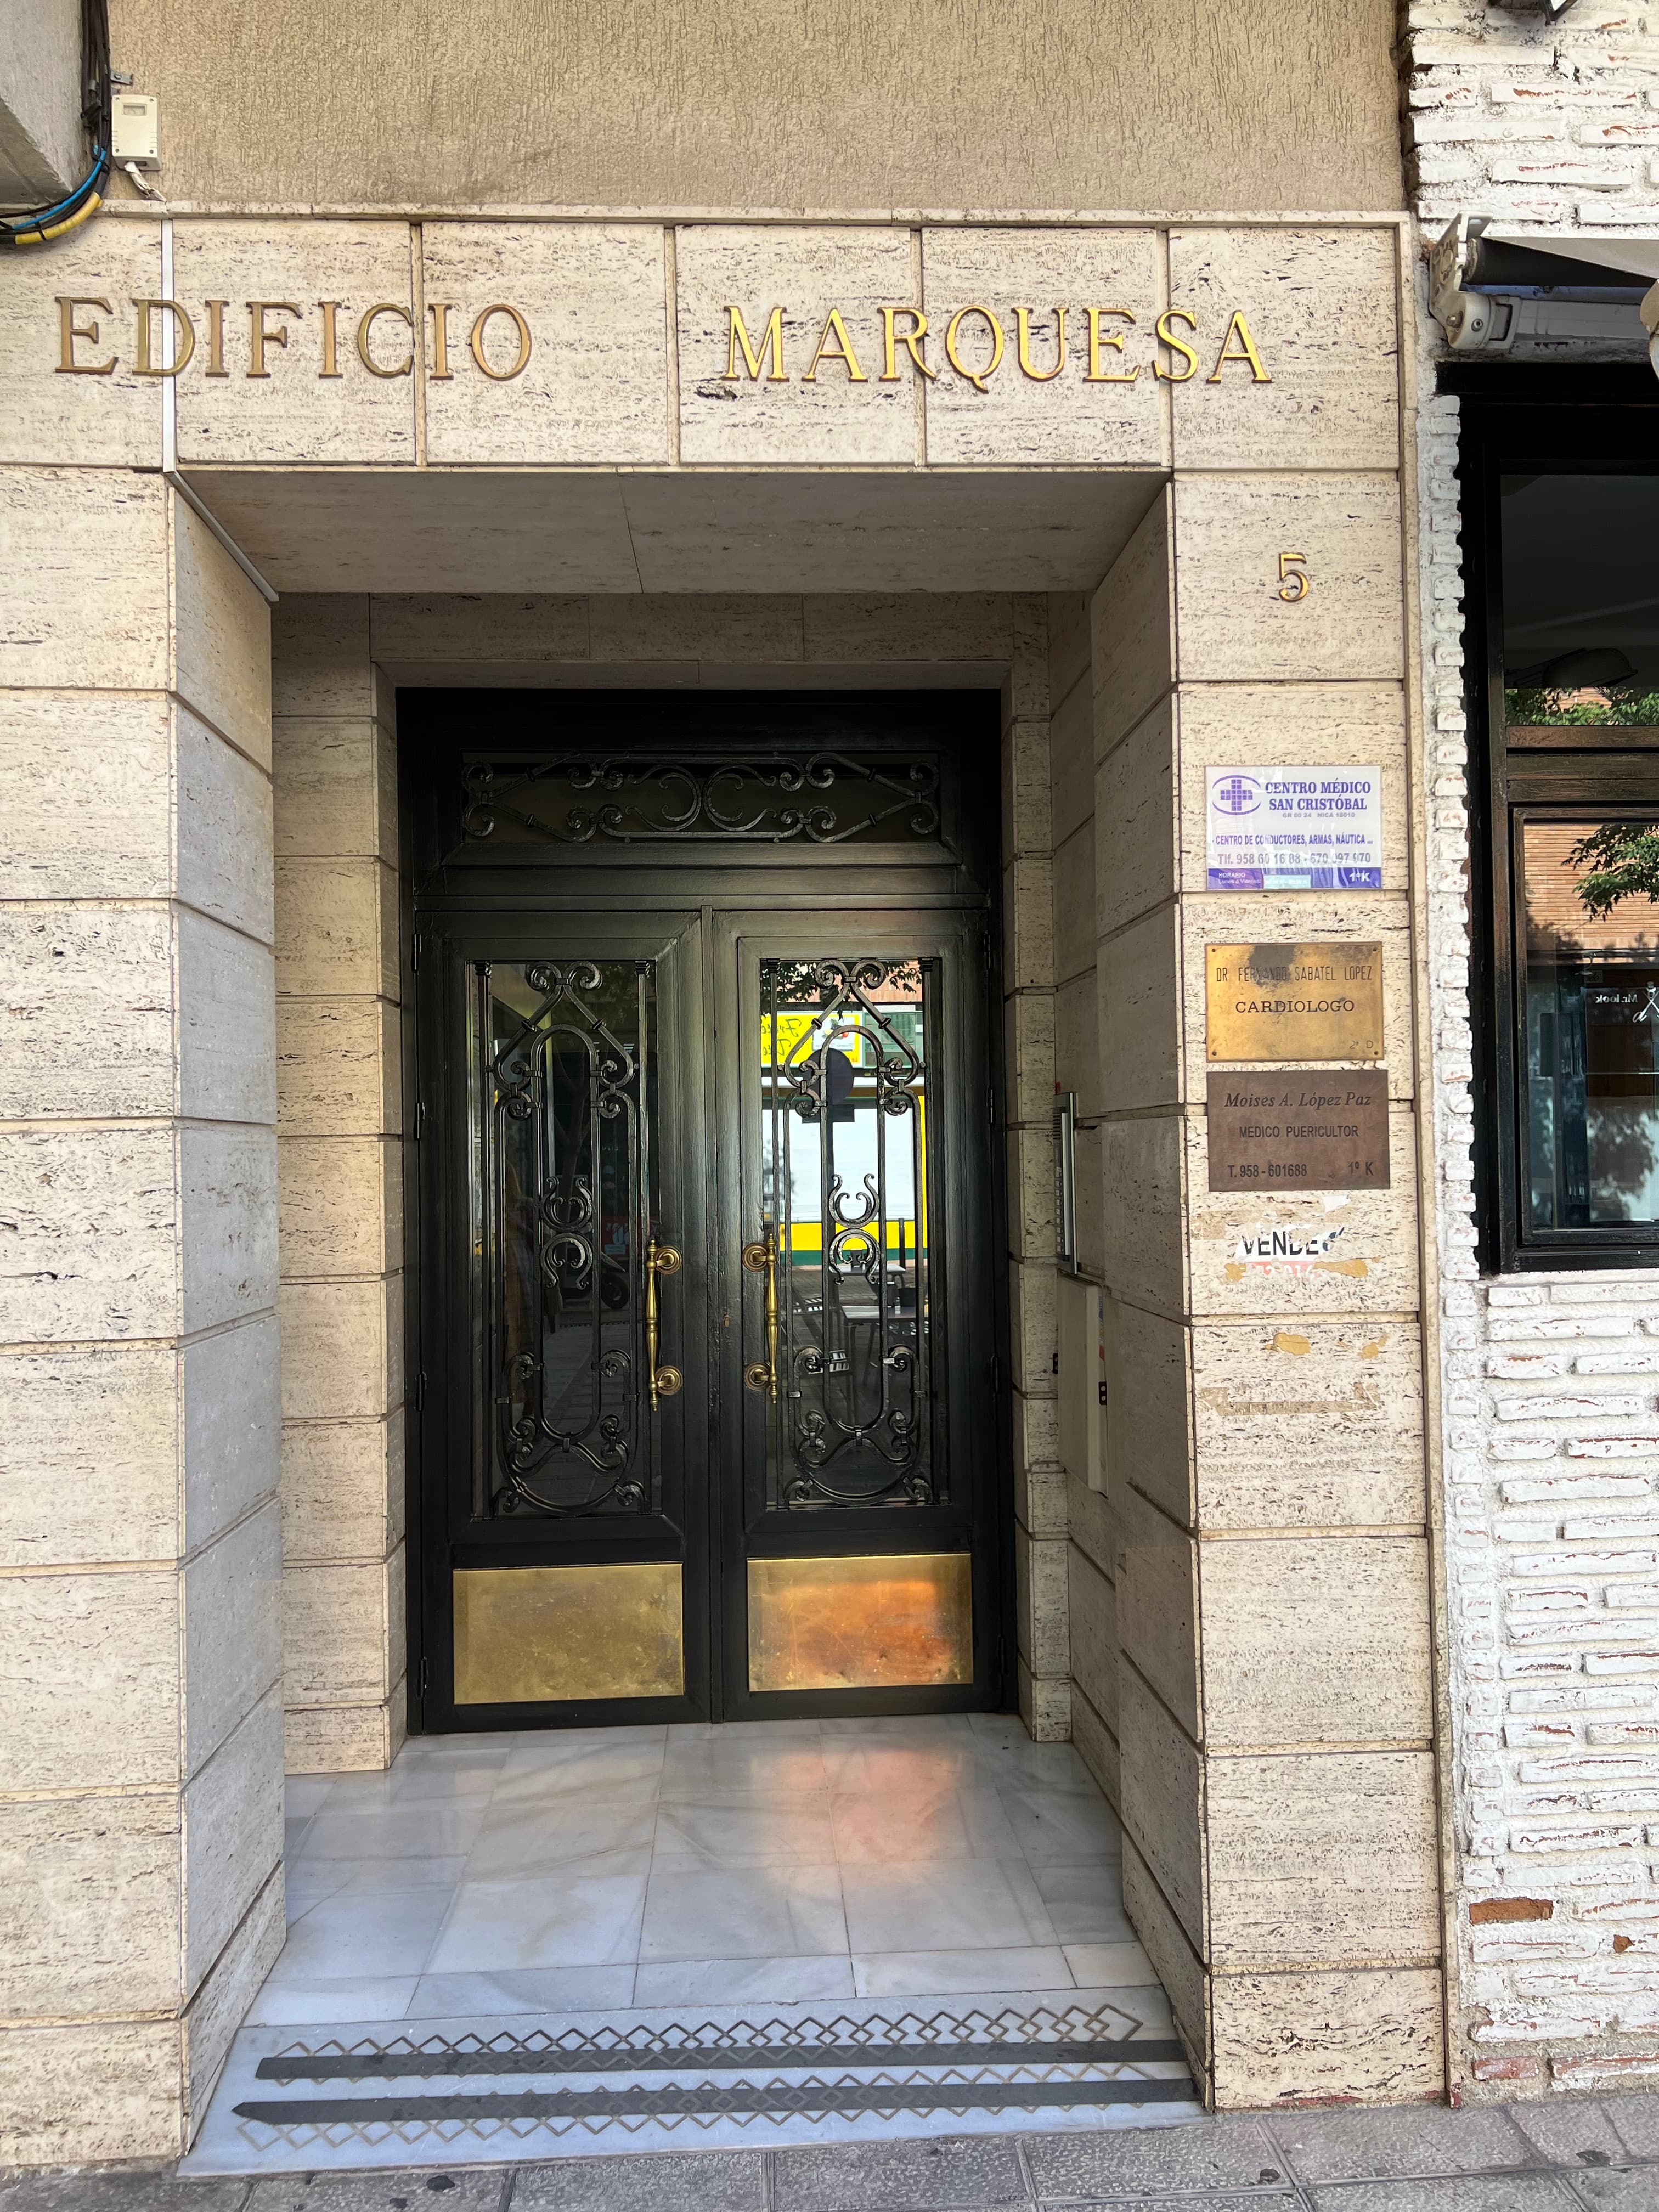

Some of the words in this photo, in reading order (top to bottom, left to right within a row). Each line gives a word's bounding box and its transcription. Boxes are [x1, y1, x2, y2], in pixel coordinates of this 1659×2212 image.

[55, 296, 532, 381] EDIFICIO
[721, 303, 1274, 393] MARQUESA
[1279, 551, 1309, 602] 5
[1265, 782, 1317, 793] CENTRO
[1321, 777, 1371, 793] MÉDICO
[1269, 798, 1293, 810] SAN
[1297, 794, 1367, 810] CRISTÓBAL
[1216, 835, 1243, 845] CENTRO
[1245, 835, 1253, 845] DE
[1255, 834, 1307, 847] CONDUCTORES,
[1309, 834, 1334, 846] ARMAS,
[1336, 832, 1365, 844] NÁUTICA
[1218, 854, 1233, 864] Tlf.
[1237, 854, 1255, 865] 958
[1258, 853, 1269, 864] 60
[1274, 853, 1285, 864] 16
[1311, 853, 1328, 864] 670
[1216, 967, 1228, 981] DR
[1295, 966, 1336, 981] SABATEL
[1345, 966, 1372, 980] LOPEZ
[1235, 1000, 1355, 1013] CARDIOLOGO
[1366, 1040, 1374, 1049] D
[1224, 1093, 1276, 1107] Moises
[1278, 1092, 1293, 1107] A.
[1298, 1092, 1342, 1110] López
[1345, 1092, 1372, 1106] Paz
[1239, 1126, 1280, 1138] MEDICO
[1286, 1125, 1359, 1137] PUERICULTOR
[1365, 1161, 1374, 1176] K
